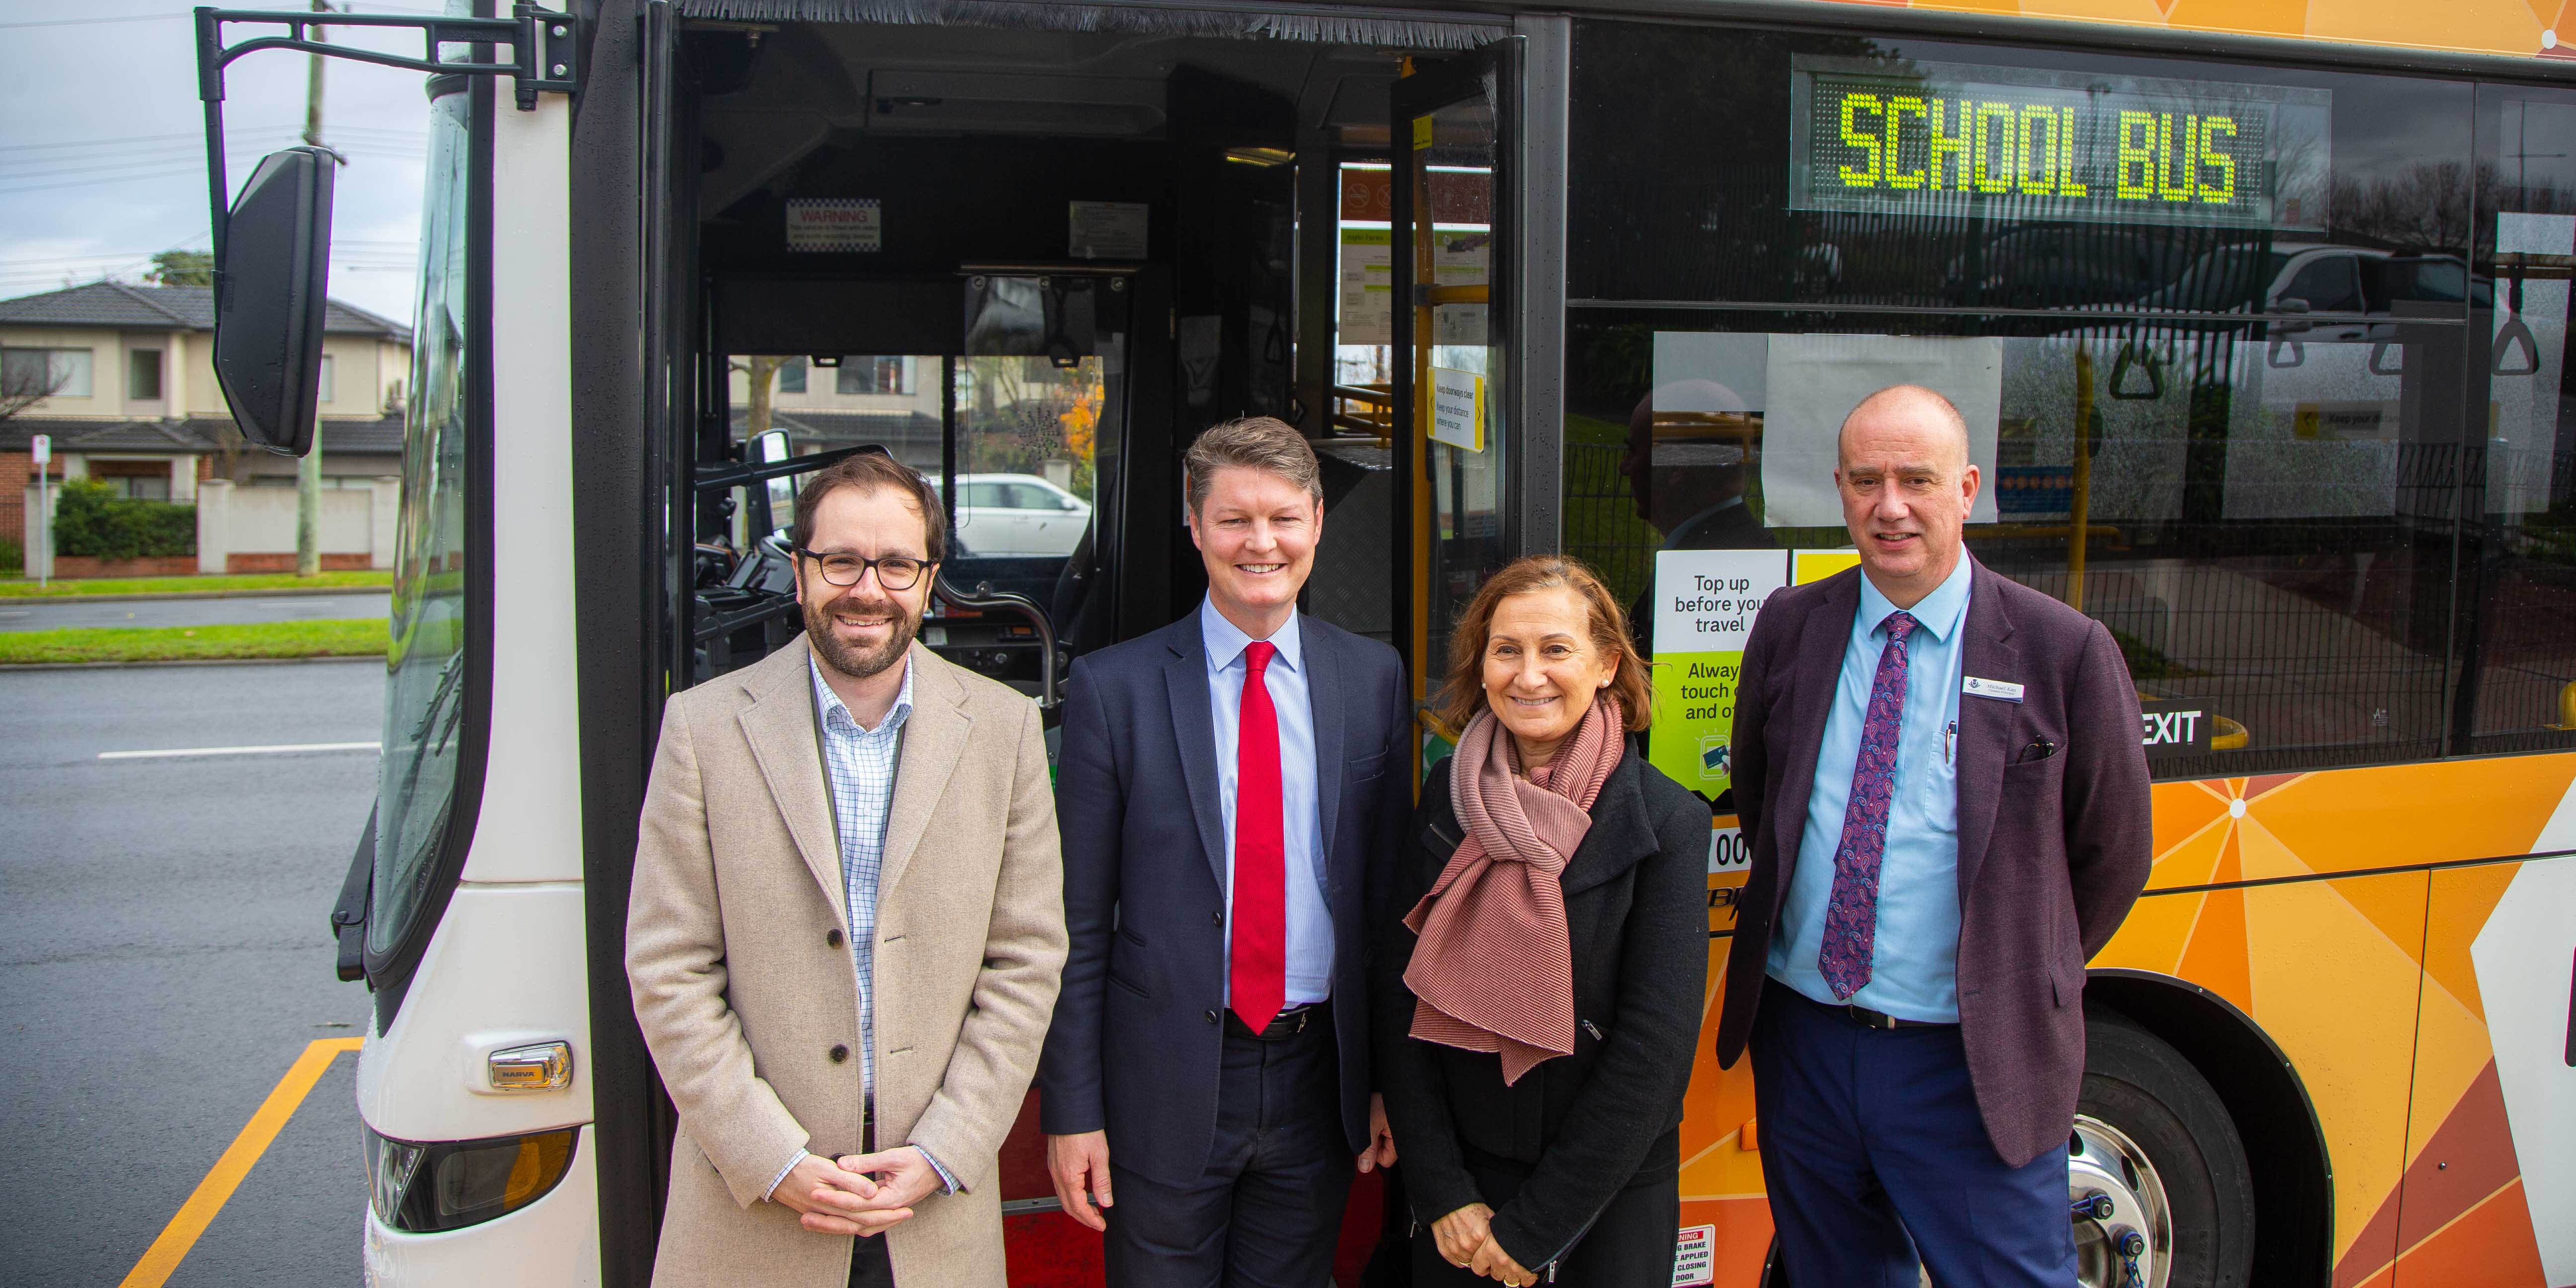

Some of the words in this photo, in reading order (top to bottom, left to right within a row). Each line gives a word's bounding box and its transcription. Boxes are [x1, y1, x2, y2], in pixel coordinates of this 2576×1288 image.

[1839, 92, 2087, 197] SCHOOL
[2117, 110, 2237, 203] BUS
[800, 210, 868, 222] WARNING
[1436, 383, 1446, 394] Keep
[1446, 386, 1463, 399] doorways
[1463, 389, 1474, 400] clear
[1436, 401, 1445, 414] Keep
[1453, 405, 1469, 418] distance
[1436, 417, 1447, 426] where
[2330, 413, 2350, 424] Keep
[2352, 415, 2371, 424] your
[2373, 413, 2400, 422] distan
[1694, 575, 1724, 595] Top
[1729, 578, 1750, 594] up
[1675, 596, 1731, 612] before
[1695, 616, 1745, 632] travel
[1688, 662, 1740, 681] Alway
[1681, 682, 1729, 699] touch
[1686, 703, 1717, 720] and
[2142, 711, 2202, 745] EXIT
[1679, 1232, 1698, 1241] NING
[1684, 1241, 1706, 1250] BRAKE
[1681, 1251, 1708, 1261] APPLIED
[1677, 1261, 1706, 1271] CLOSING
